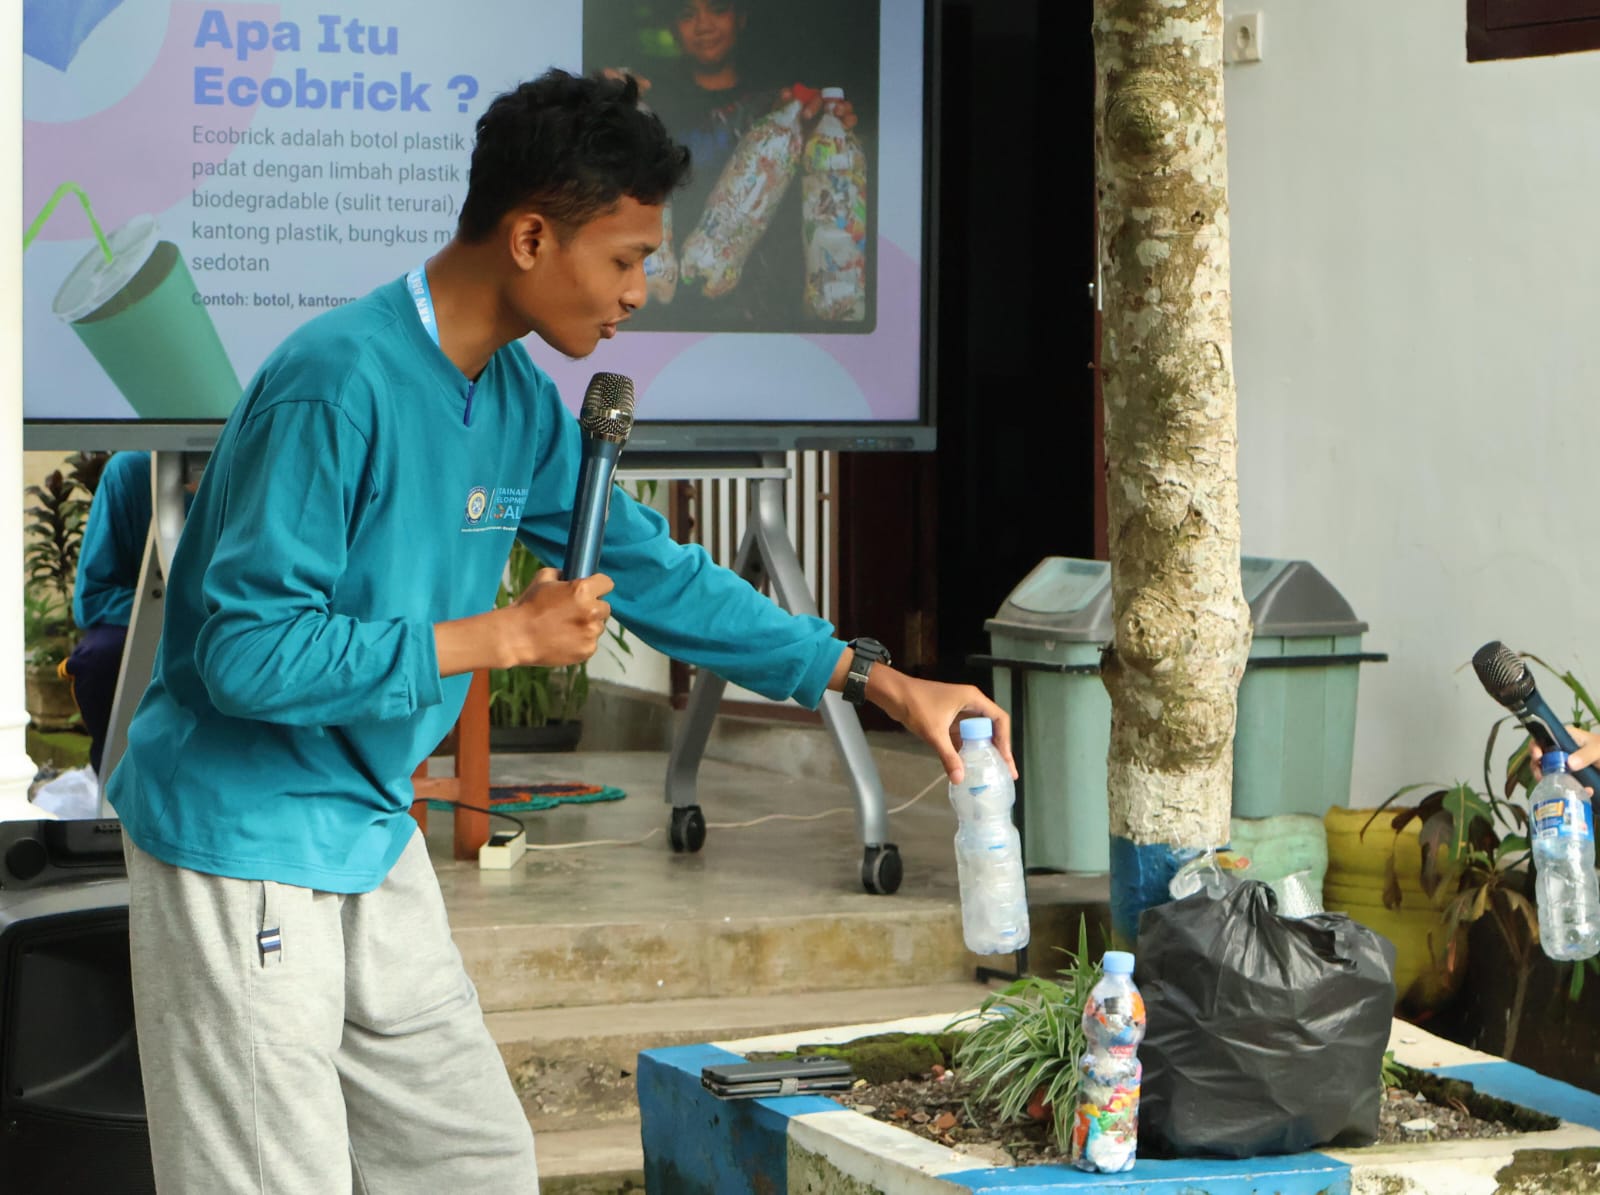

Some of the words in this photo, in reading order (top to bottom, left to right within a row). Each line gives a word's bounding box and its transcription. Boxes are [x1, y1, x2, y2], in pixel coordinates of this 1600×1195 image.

[193, 9, 300, 61] Apa
[317, 14, 398, 55] Itu
[193, 66, 431, 112] Ecobrick
[447, 74, 479, 113] ?
[192, 125, 275, 146] Ecobrick
[281, 128, 344, 148] adalah
[350, 130, 398, 150] botol
[404, 131, 465, 153] plastik
[192, 159, 247, 180] padat
[253, 160, 323, 183] dengan
[329, 161, 393, 181] limbah
[399, 163, 460, 184] plastik
[192, 189, 329, 213] biodegradable
[335, 191, 381, 214] (sulit
[388, 193, 459, 217] terurai),
[192, 221, 270, 244] kantong
[276, 223, 343, 245] plastik,
[349, 224, 428, 246] bungkus
[192, 253, 270, 273] sedotan
[192, 291, 249, 307] Contoh:
[253, 292, 294, 309] botol,
